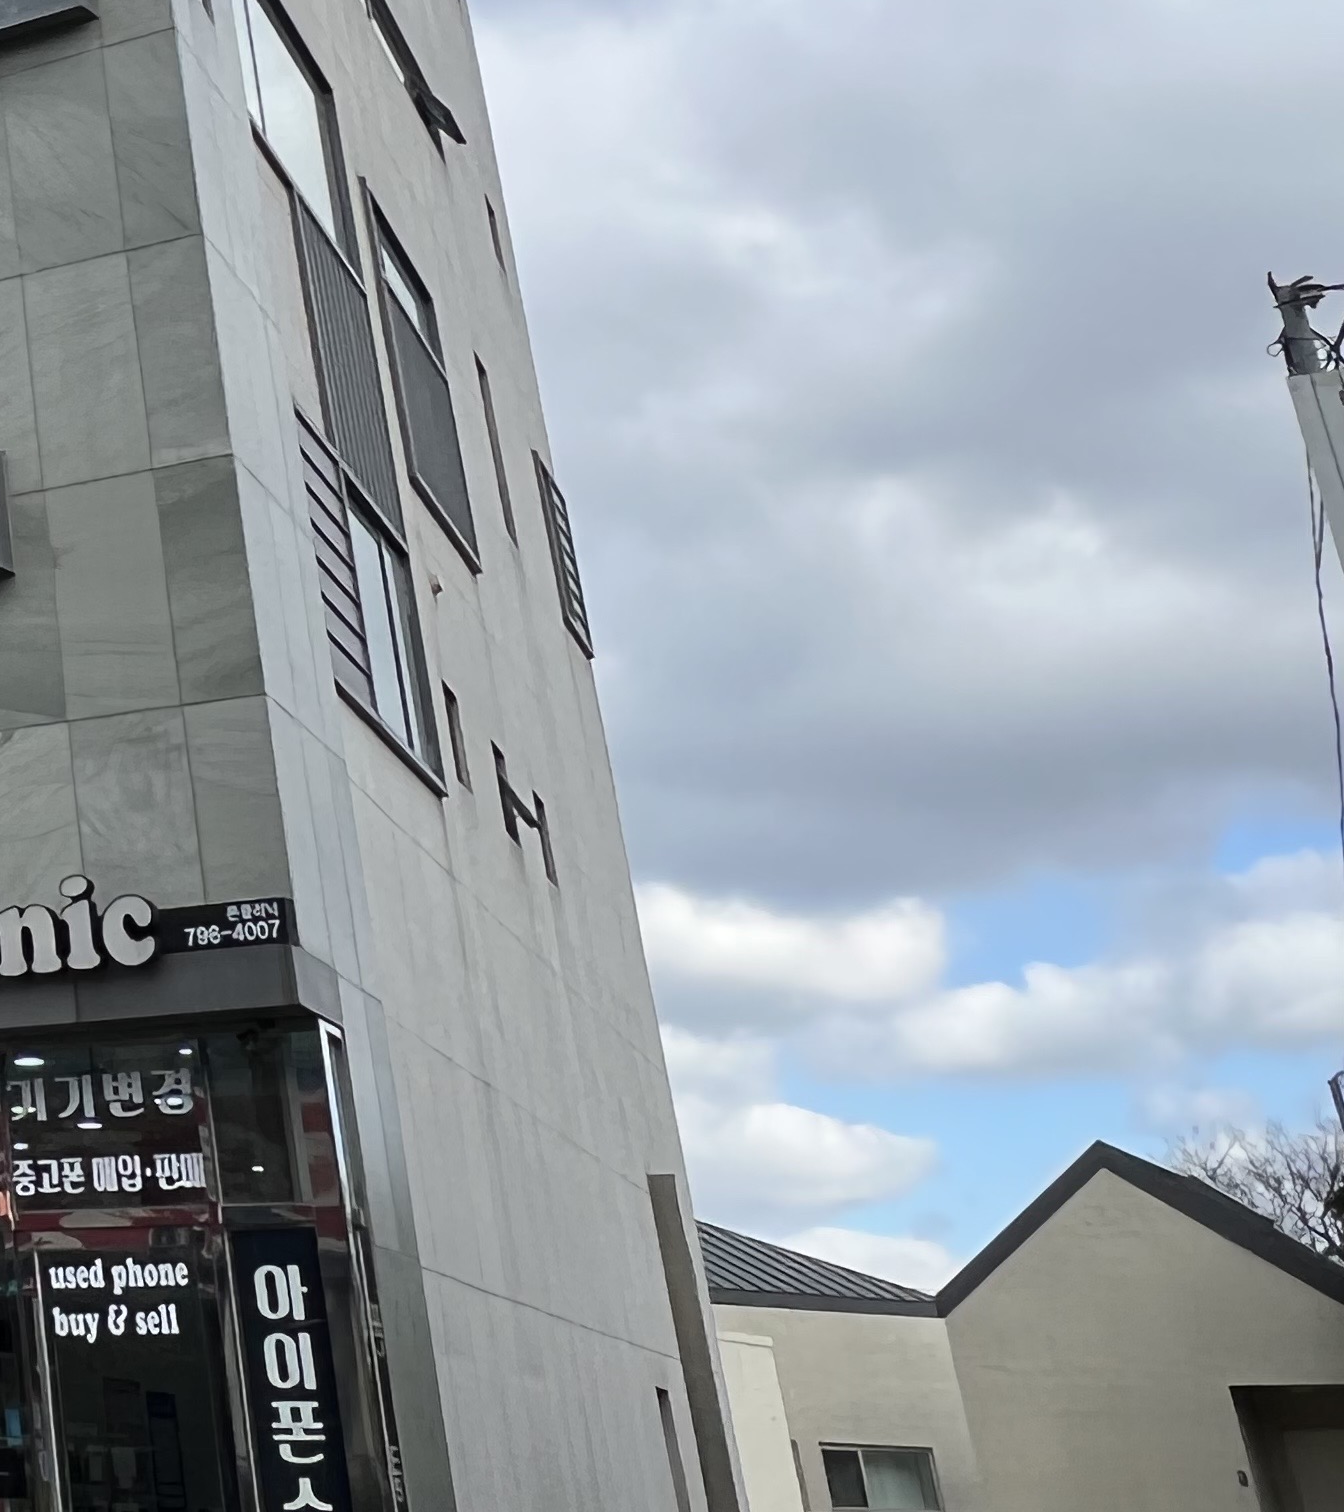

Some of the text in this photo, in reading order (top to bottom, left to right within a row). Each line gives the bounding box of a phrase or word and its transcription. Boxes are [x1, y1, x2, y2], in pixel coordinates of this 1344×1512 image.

[184, 919, 280, 946] 796-4007
[6, 1068, 194, 1121] 기기변경
[12, 1157, 85, 1196] 중고폰
[48, 1257, 189, 1295] used phone
[52, 1303, 180, 1344] buy & sell
